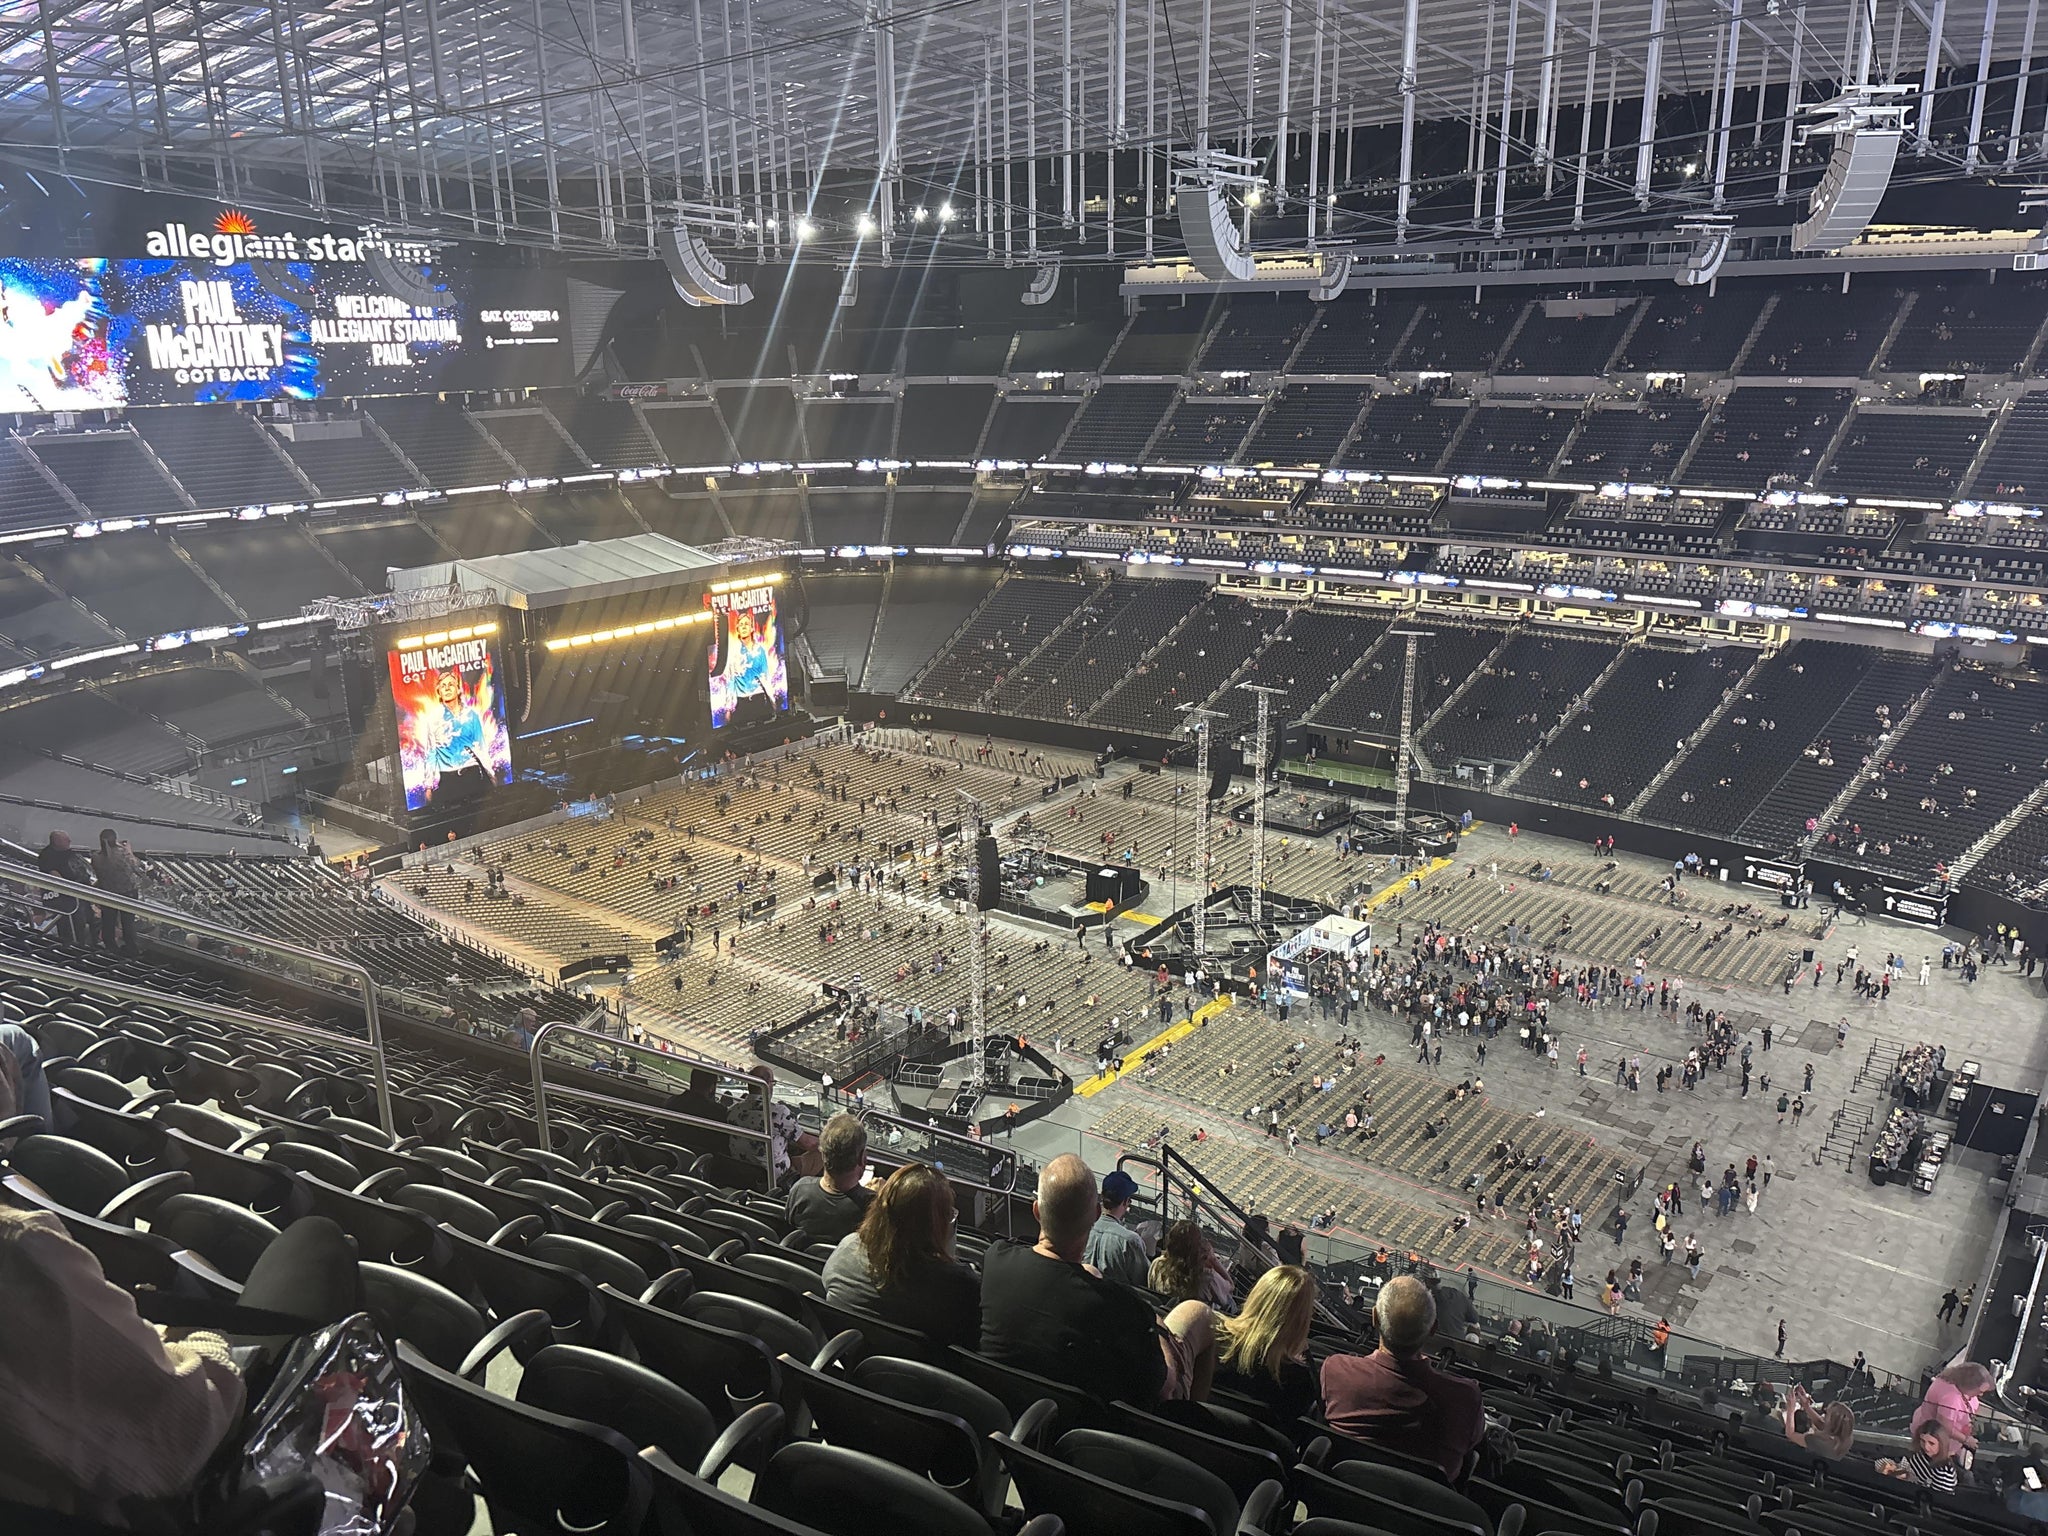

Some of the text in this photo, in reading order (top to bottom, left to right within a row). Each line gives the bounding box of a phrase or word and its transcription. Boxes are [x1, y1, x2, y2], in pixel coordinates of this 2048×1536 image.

[146, 223, 300, 266] allegiant
[180, 280, 243, 324] PAUL
[334, 295, 412, 319] WELCOME
[503, 310, 551, 322] OCTOBER
[310, 319, 392, 343] ALLEGIANT
[146, 324, 284, 369] McCARTNEY
[371, 343, 412, 366] PAUL
[175, 367, 270, 384] GOT BACK
[730, 586, 773, 610] McCARTNEY
[752, 603, 773, 615] BACK
[400, 638, 487, 675] PAUL McCARTNEY
[459, 660, 489, 672] BACK
[403, 672, 427, 684] GOT
